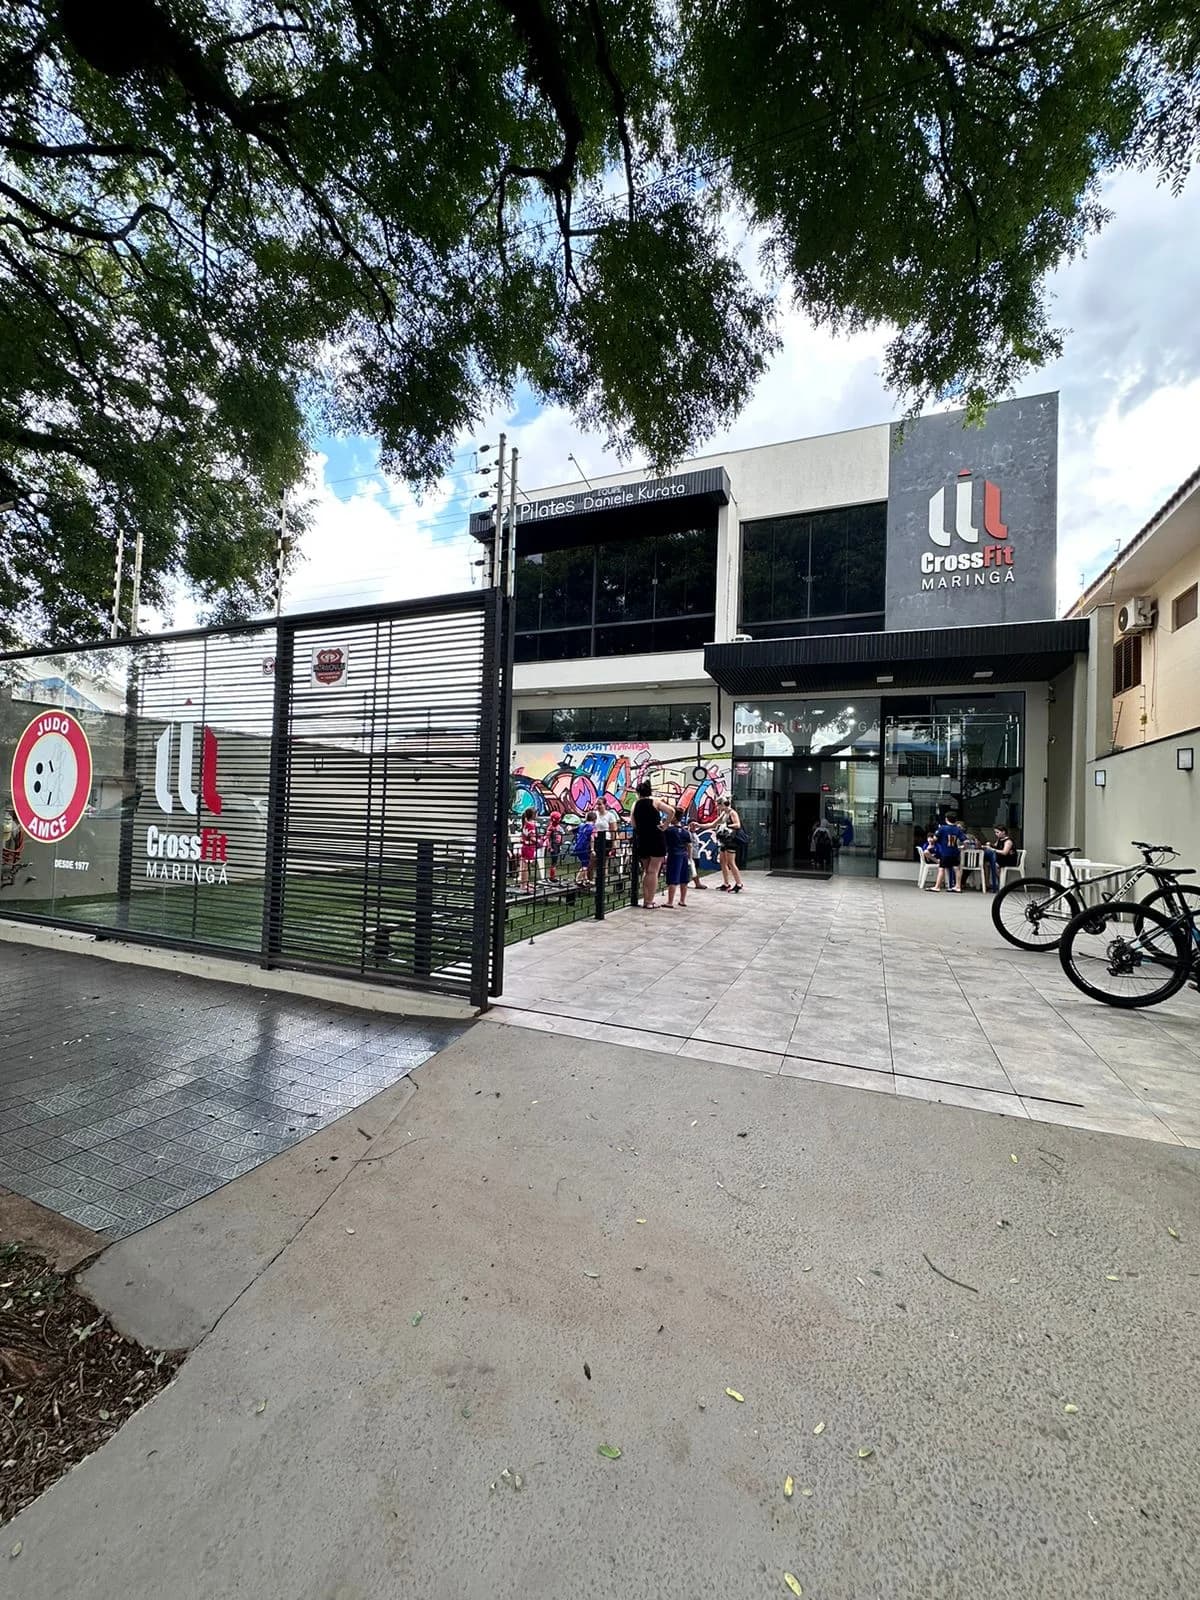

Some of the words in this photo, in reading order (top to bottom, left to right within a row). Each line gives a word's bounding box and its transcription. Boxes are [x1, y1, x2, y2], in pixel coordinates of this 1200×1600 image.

[520, 500, 575, 521] Pilates
[583, 491, 634, 510] Daniele
[638, 484, 686, 499] Kurata
[921, 545, 1014, 574] CrossFit
[921, 567, 1015, 591] MARINGÁ
[802, 718, 878, 734] MARGÁ
[28, 814, 68, 838] AMCF
[146, 825, 229, 863] CrossFit
[54, 859, 75, 869] DESDE
[75, 861, 90, 871] 1977
[146, 861, 229, 885] MARINGÁ
